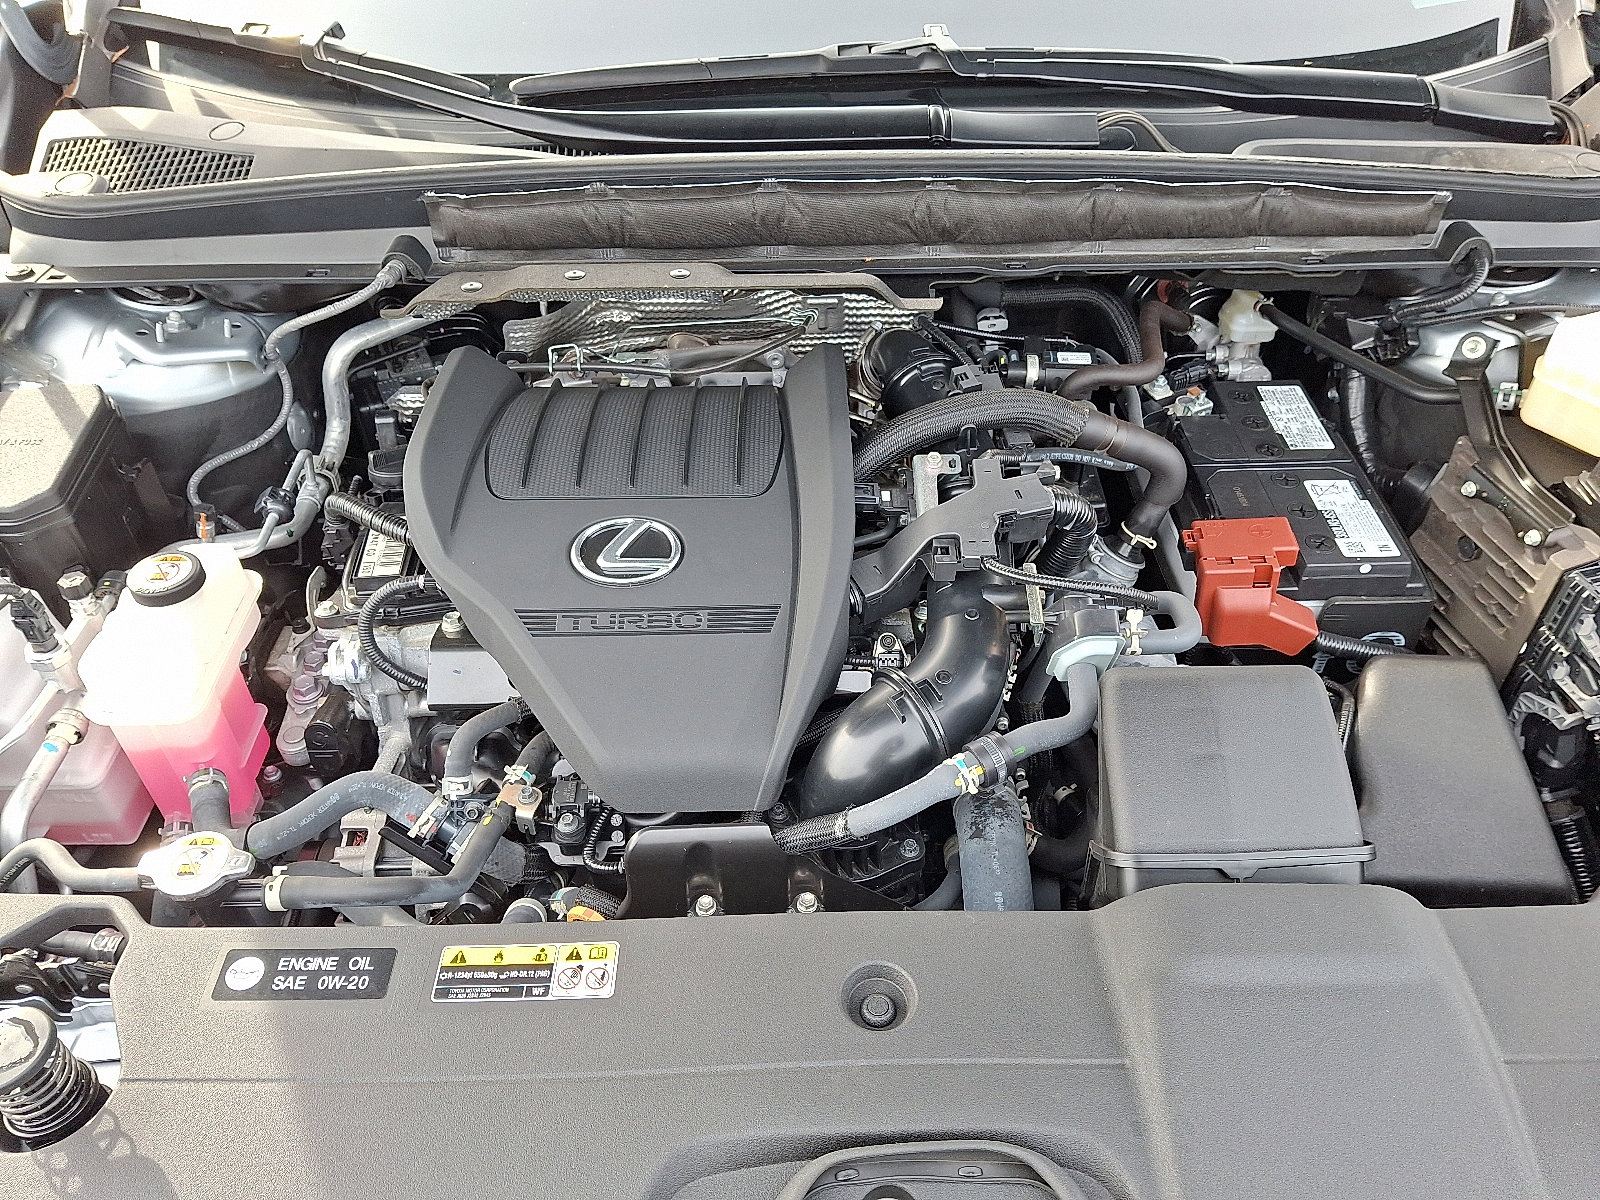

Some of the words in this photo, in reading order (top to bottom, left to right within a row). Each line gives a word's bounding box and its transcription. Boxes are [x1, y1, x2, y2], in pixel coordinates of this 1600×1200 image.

[560, 611, 705, 631] TURBO
[277, 956, 340, 971] ENGINE
[348, 956, 375, 971] OIL
[271, 975, 308, 991] SAE
[317, 975, 370, 990] 0W-20
[531, 987, 546, 996] WF
